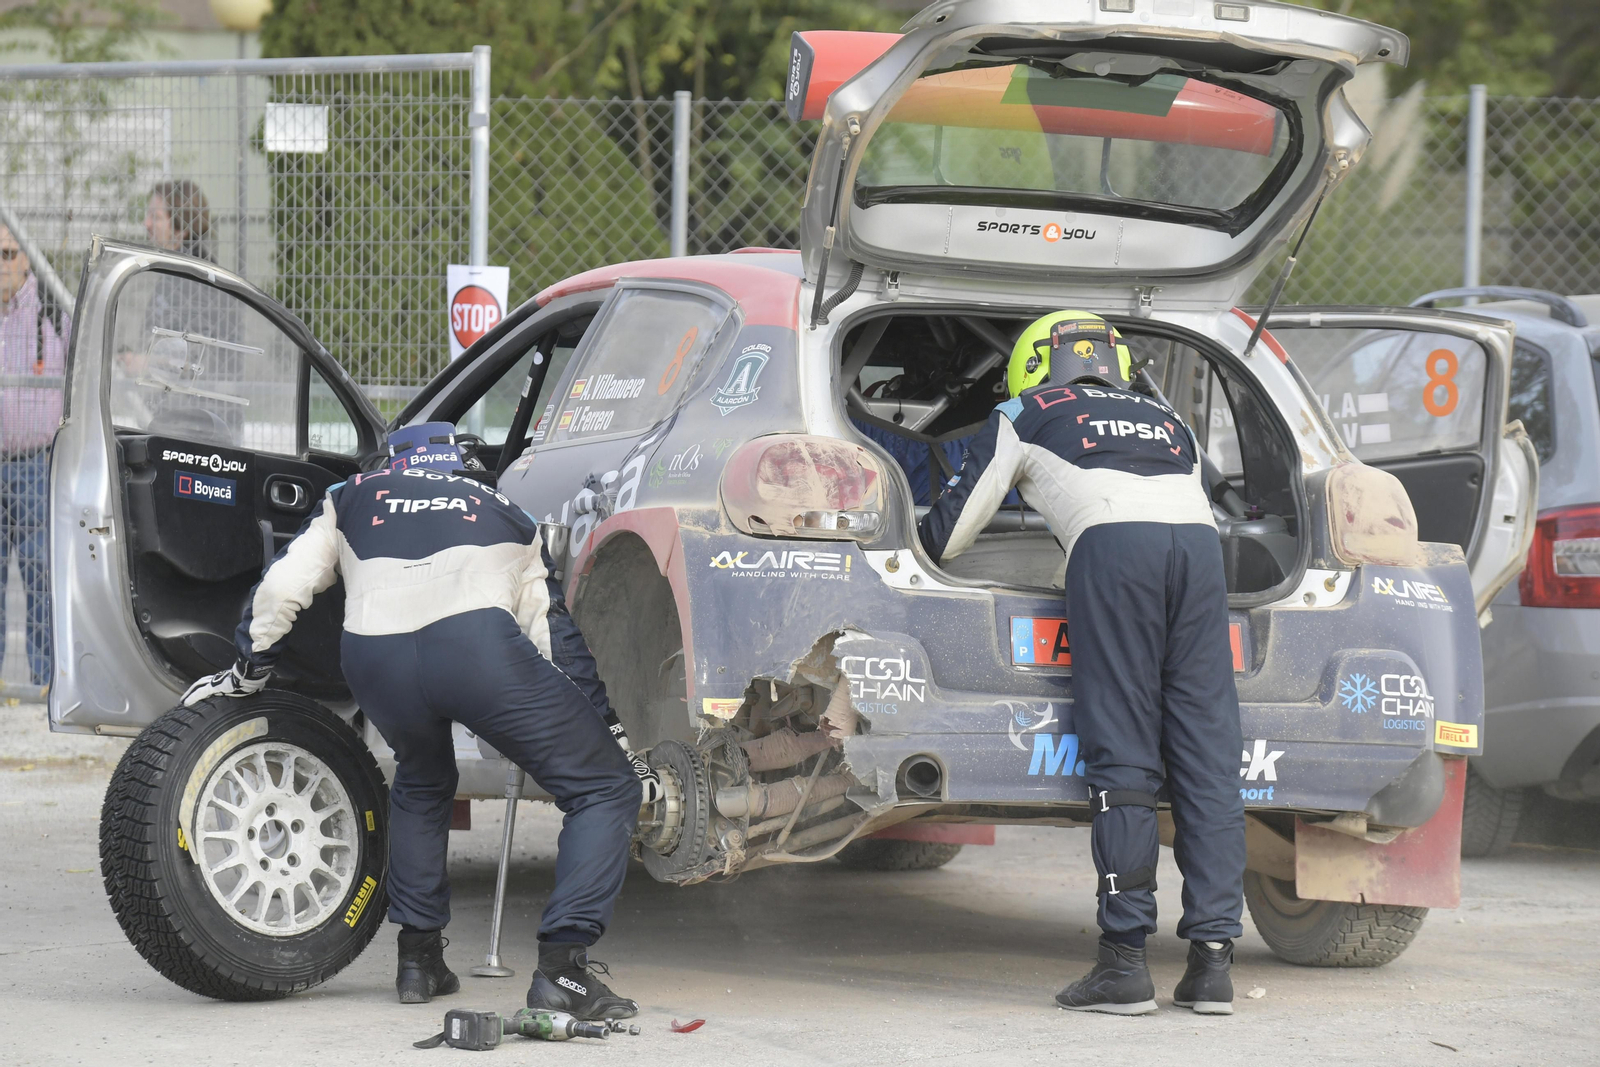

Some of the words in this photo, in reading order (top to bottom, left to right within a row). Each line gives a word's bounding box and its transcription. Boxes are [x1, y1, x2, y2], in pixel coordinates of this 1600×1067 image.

[453, 303, 499, 334] STOP
[742, 343, 772, 354] COLEGIO
[658, 326, 698, 396] 8
[725, 361, 752, 394] A
[1422, 348, 1459, 417] 8
[1089, 420, 1172, 445] TIPSA
[410, 452, 458, 466] Boyacá
[194, 480, 232, 500] Boyacá
[385, 497, 468, 513] TIPSA
[821, 573, 850, 581] CARE
[1019, 646, 1028, 657] P
[841, 656, 926, 684] COOL
[852, 702, 898, 715] GISTICS
[1383, 719, 1426, 731] LOGISTICS
[1439, 725, 1471, 743] PIRELLI
[344, 875, 378, 928] PIRELLI
[555, 976, 588, 997] sparco
